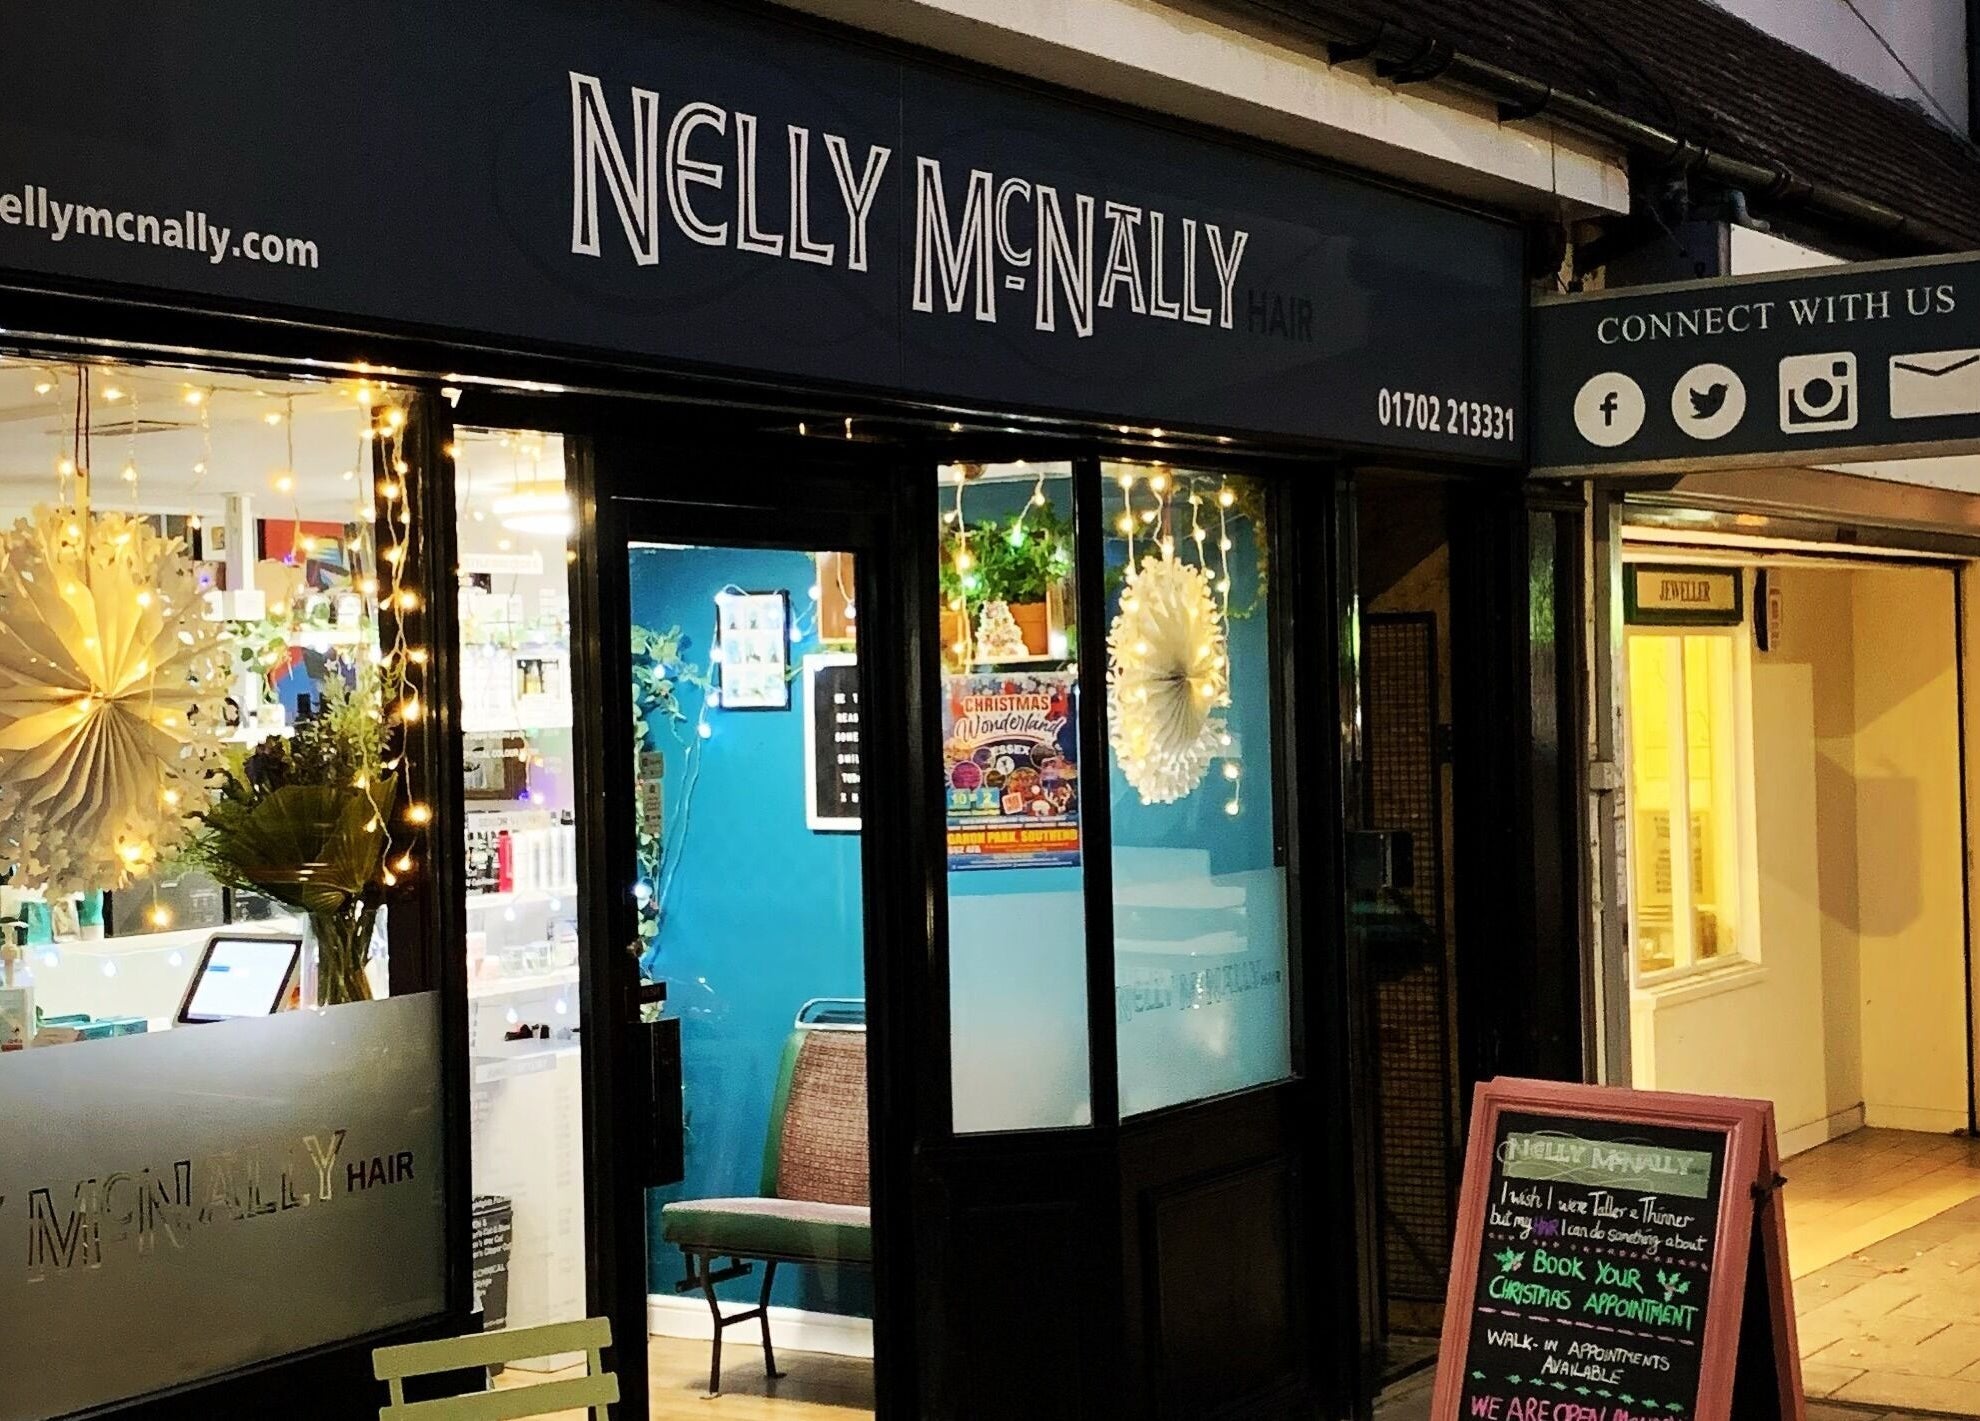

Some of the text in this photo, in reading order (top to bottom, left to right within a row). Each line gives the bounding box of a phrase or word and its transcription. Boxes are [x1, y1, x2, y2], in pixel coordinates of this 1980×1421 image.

[0, 184, 319, 269] ellymcnally.com
[1597, 284, 1956, 345] CONNECT WITH US
[1378, 387, 1514, 442] 01702 213331
[1659, 579, 1711, 602] JEWELLER
[964, 696, 1050, 713] CHRISTMAS
[956, 714, 1064, 742] Wonderland
[346, 1151, 415, 1193] HAIR
[1509, 1185, 1543, 1209] wish
[1558, 1199, 1588, 1215] were
[1588, 1191, 1626, 1219] Taller
[1638, 1196, 1695, 1228] Thinner
[1489, 1203, 1513, 1227] but
[1513, 1216, 1533, 1240] my
[1568, 1222, 1588, 1238] can
[1589, 1220, 1605, 1240] do
[1607, 1227, 1662, 1255] something
[1665, 1234, 1708, 1251] about
[1595, 1260, 1644, 1294] YOUR
[1489, 1275, 1699, 1332] CHRISTMAS APPOINTMENT
[1541, 1355, 1625, 1385] AVAILABLE
[1567, 1341, 1670, 1372] APPOINTMENTS
[1471, 1395, 1503, 1421] WE
[1506, 1396, 1550, 1421] ARE
